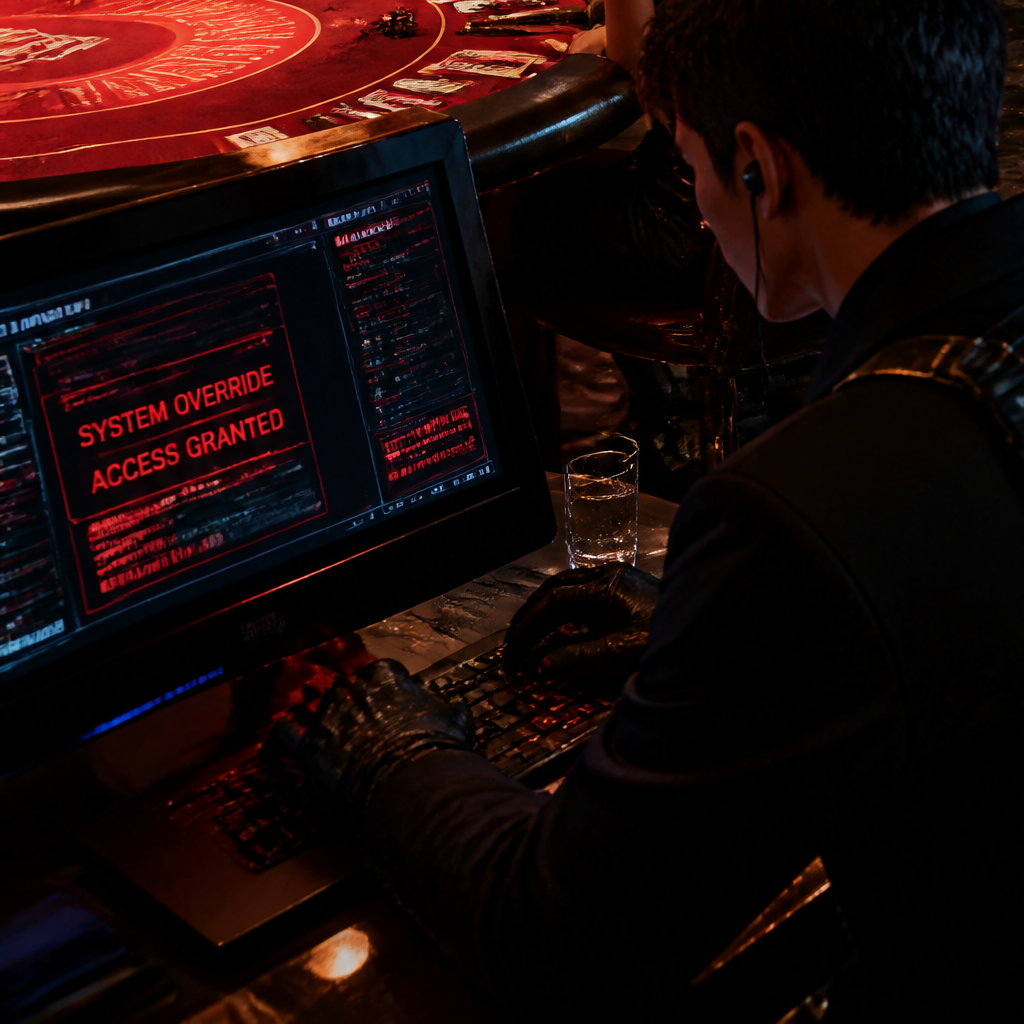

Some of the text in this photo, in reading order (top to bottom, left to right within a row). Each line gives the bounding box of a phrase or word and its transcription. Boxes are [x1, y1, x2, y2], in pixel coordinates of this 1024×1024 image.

[79, 364, 275, 449] SYSTEM OVERRIDE
[91, 406, 285, 495] ACCESS GRANTED
